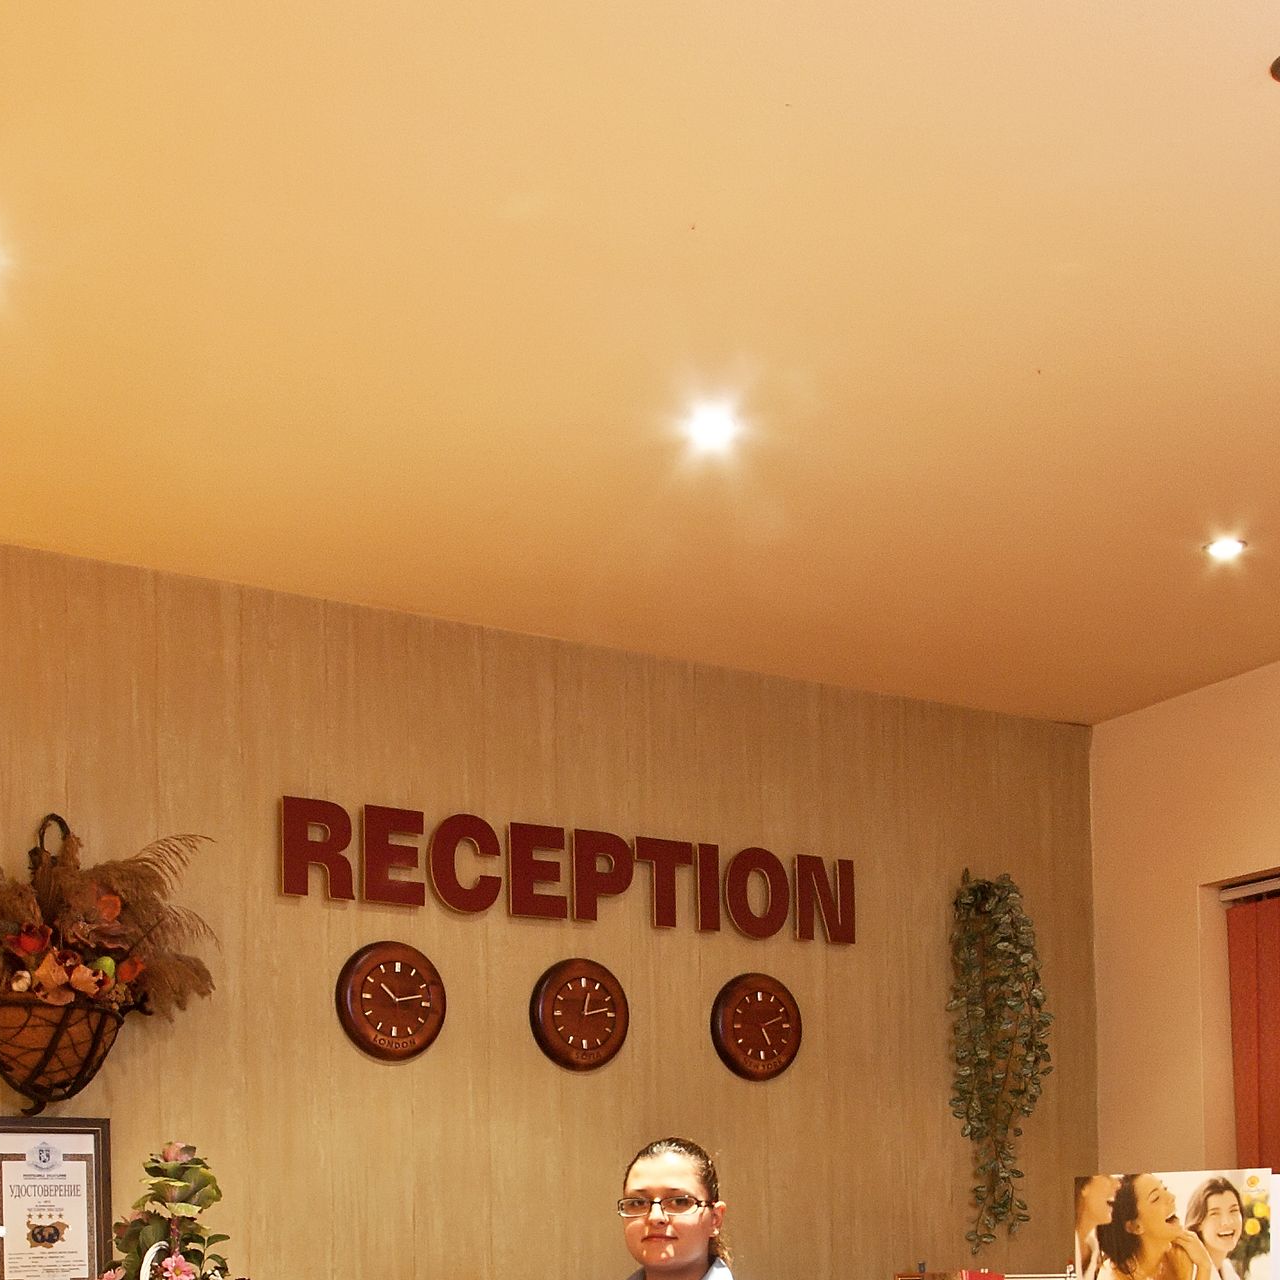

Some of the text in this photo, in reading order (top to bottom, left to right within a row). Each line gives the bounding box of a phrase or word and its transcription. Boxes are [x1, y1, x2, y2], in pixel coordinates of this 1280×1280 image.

[280, 794, 857, 945] RECEPTION
[372, 1033, 416, 1050] LONDON
[9, 1184, 81, 1198] УДОСТОВЕРЕНИЕ
